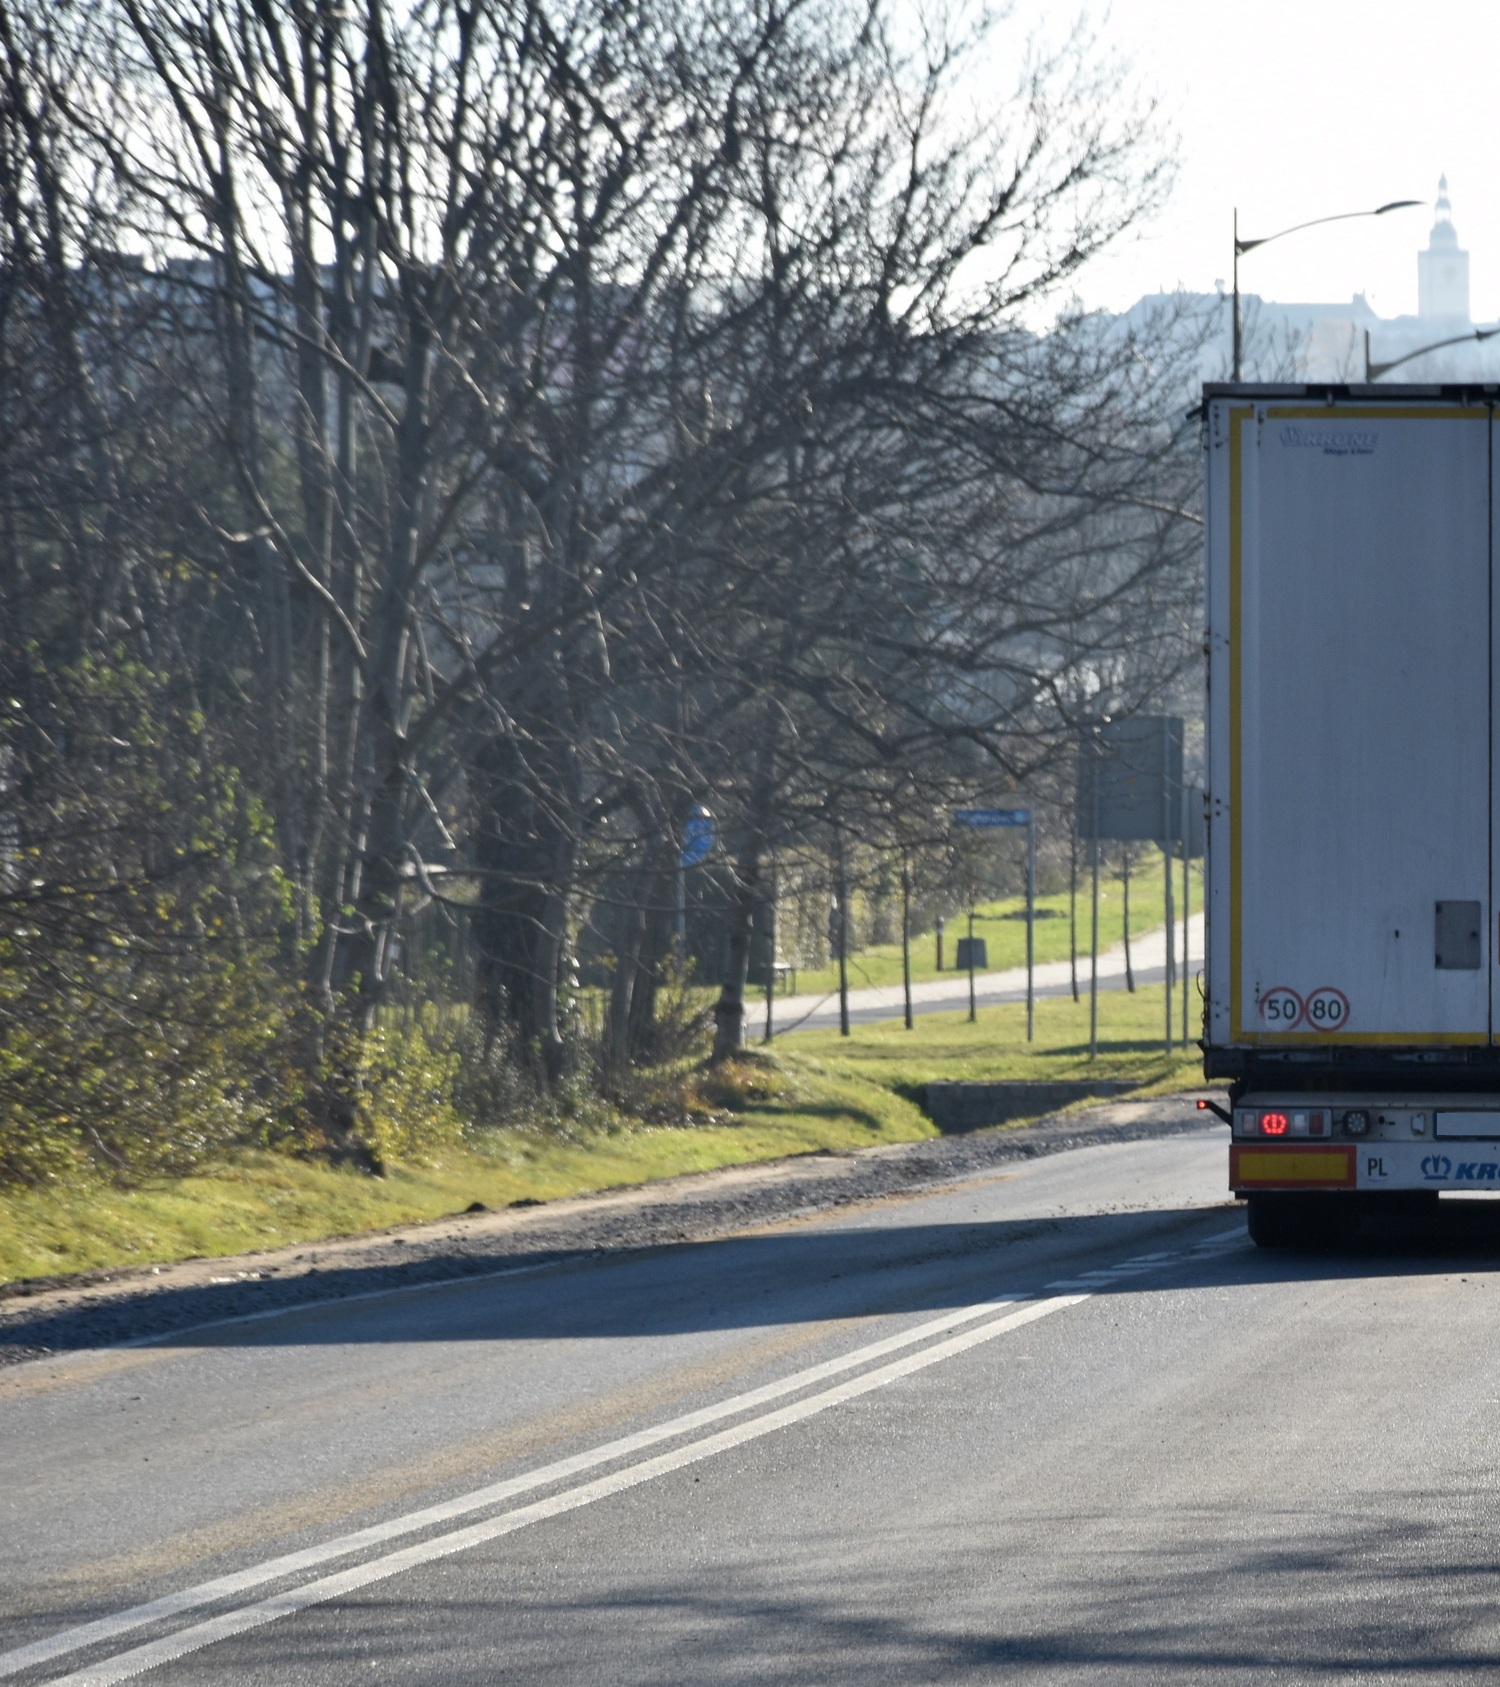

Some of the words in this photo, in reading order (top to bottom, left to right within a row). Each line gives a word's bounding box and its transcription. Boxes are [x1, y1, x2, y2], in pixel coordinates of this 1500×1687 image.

[1268, 999, 1296, 1020] 50
[1312, 999, 1341, 1020] 80
[1367, 1157, 1388, 1177] PL
